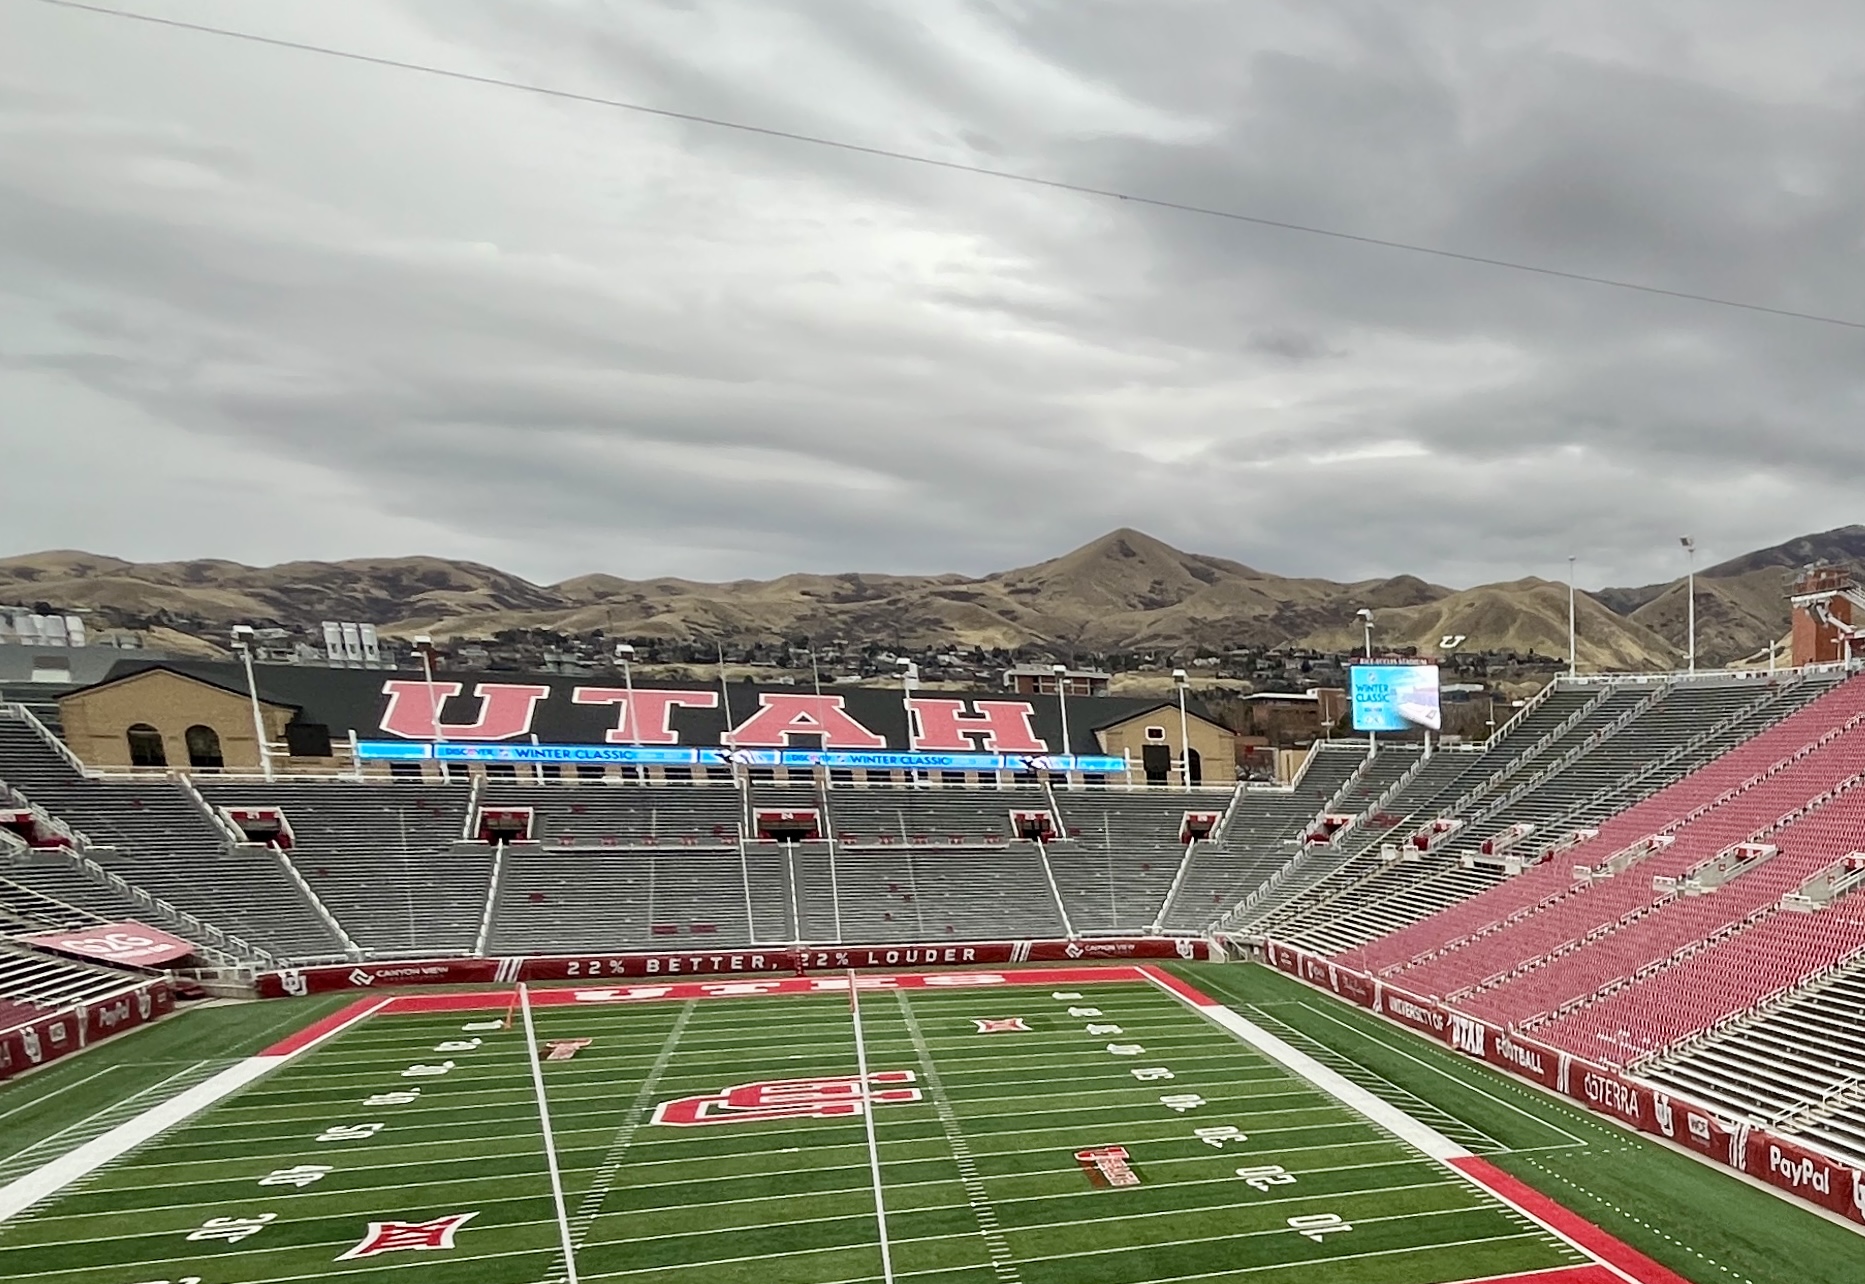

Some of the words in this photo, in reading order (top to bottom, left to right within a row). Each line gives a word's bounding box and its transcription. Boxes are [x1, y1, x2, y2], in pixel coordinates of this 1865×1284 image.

[1439, 635, 1466, 649] U
[1355, 684, 1389, 693] WINTER
[1355, 694, 1390, 703] CLASSIC
[380, 679, 1049, 752] UTAH
[515, 749, 573, 759] WINTER
[575, 749, 634, 760] CLASSIC
[850, 755, 898, 765] WINTER
[901, 756, 951, 766] CLASSIC
[567, 960, 625, 976] 22%
[646, 955, 780, 973] BETTER,
[868, 947, 977, 965] LOUDER
[1235, 1165, 1298, 1187] 20
[1769, 1144, 1831, 1196] PayPal
[1286, 1213, 1354, 1238] 10
